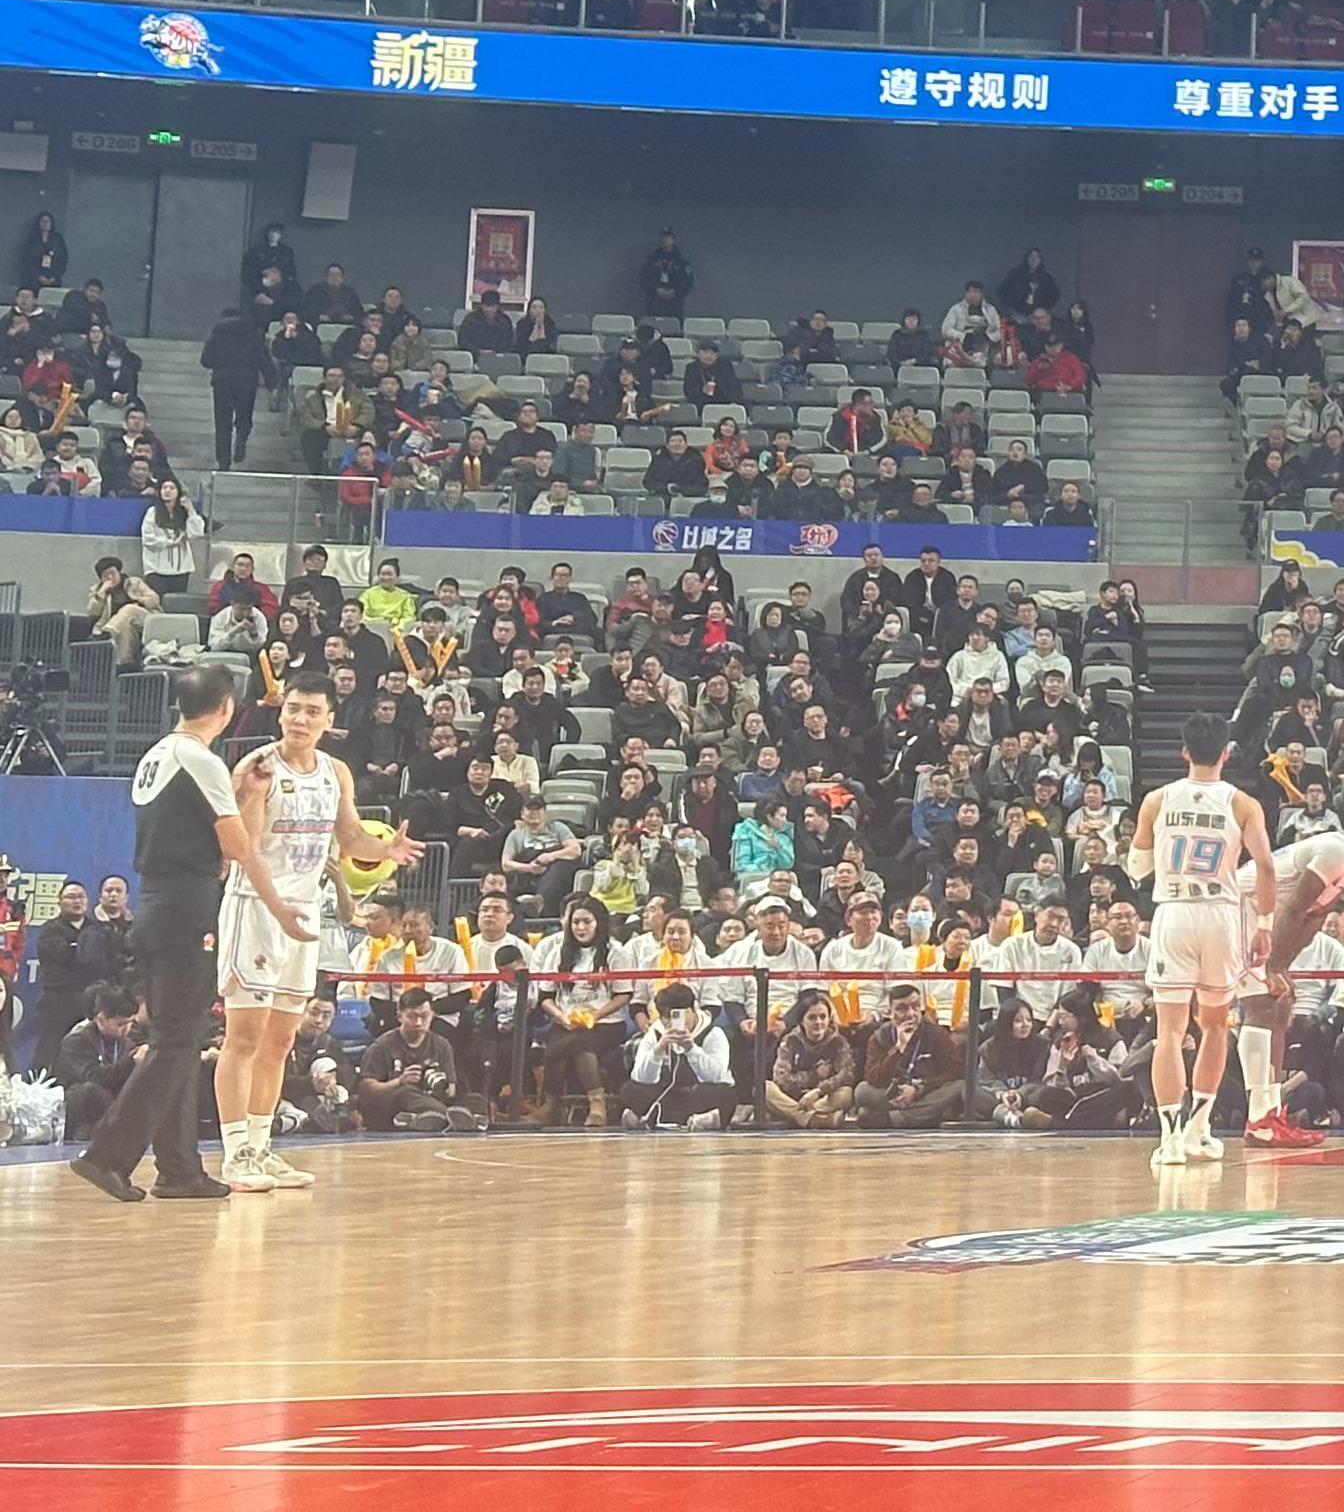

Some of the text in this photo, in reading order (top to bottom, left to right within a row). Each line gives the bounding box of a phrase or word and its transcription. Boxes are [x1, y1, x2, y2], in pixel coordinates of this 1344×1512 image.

[371, 31, 479, 90] 新疆
[879, 67, 1049, 111] 遵守规则
[1173, 79, 1340, 121] 尊重对手
[138, 760, 160, 789] 39
[1167, 834, 1228, 877] 19
